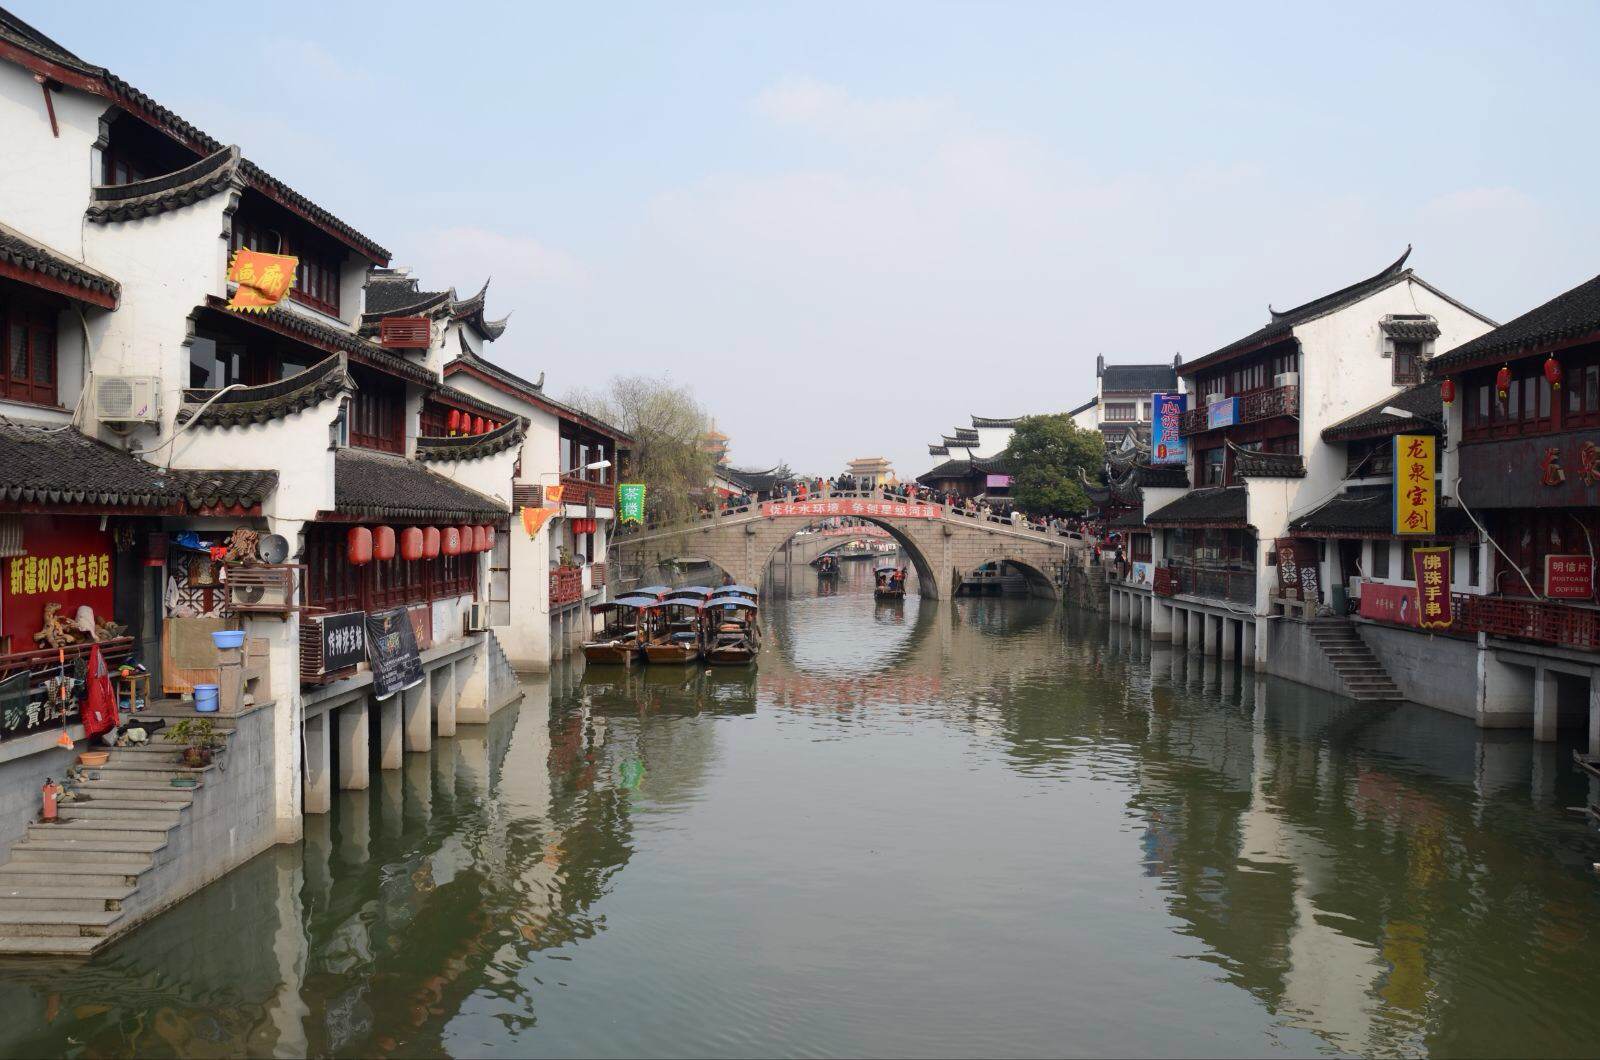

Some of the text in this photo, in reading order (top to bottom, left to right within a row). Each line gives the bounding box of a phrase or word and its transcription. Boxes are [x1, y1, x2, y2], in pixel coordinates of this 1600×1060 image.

[1405, 439, 1429, 531] 龙泉宝剑
[11, 553, 110, 595] 新疆和田玉专卖店
[1423, 555, 1442, 617] 佛珠手串
[1552, 562, 1588, 572] 明信片
